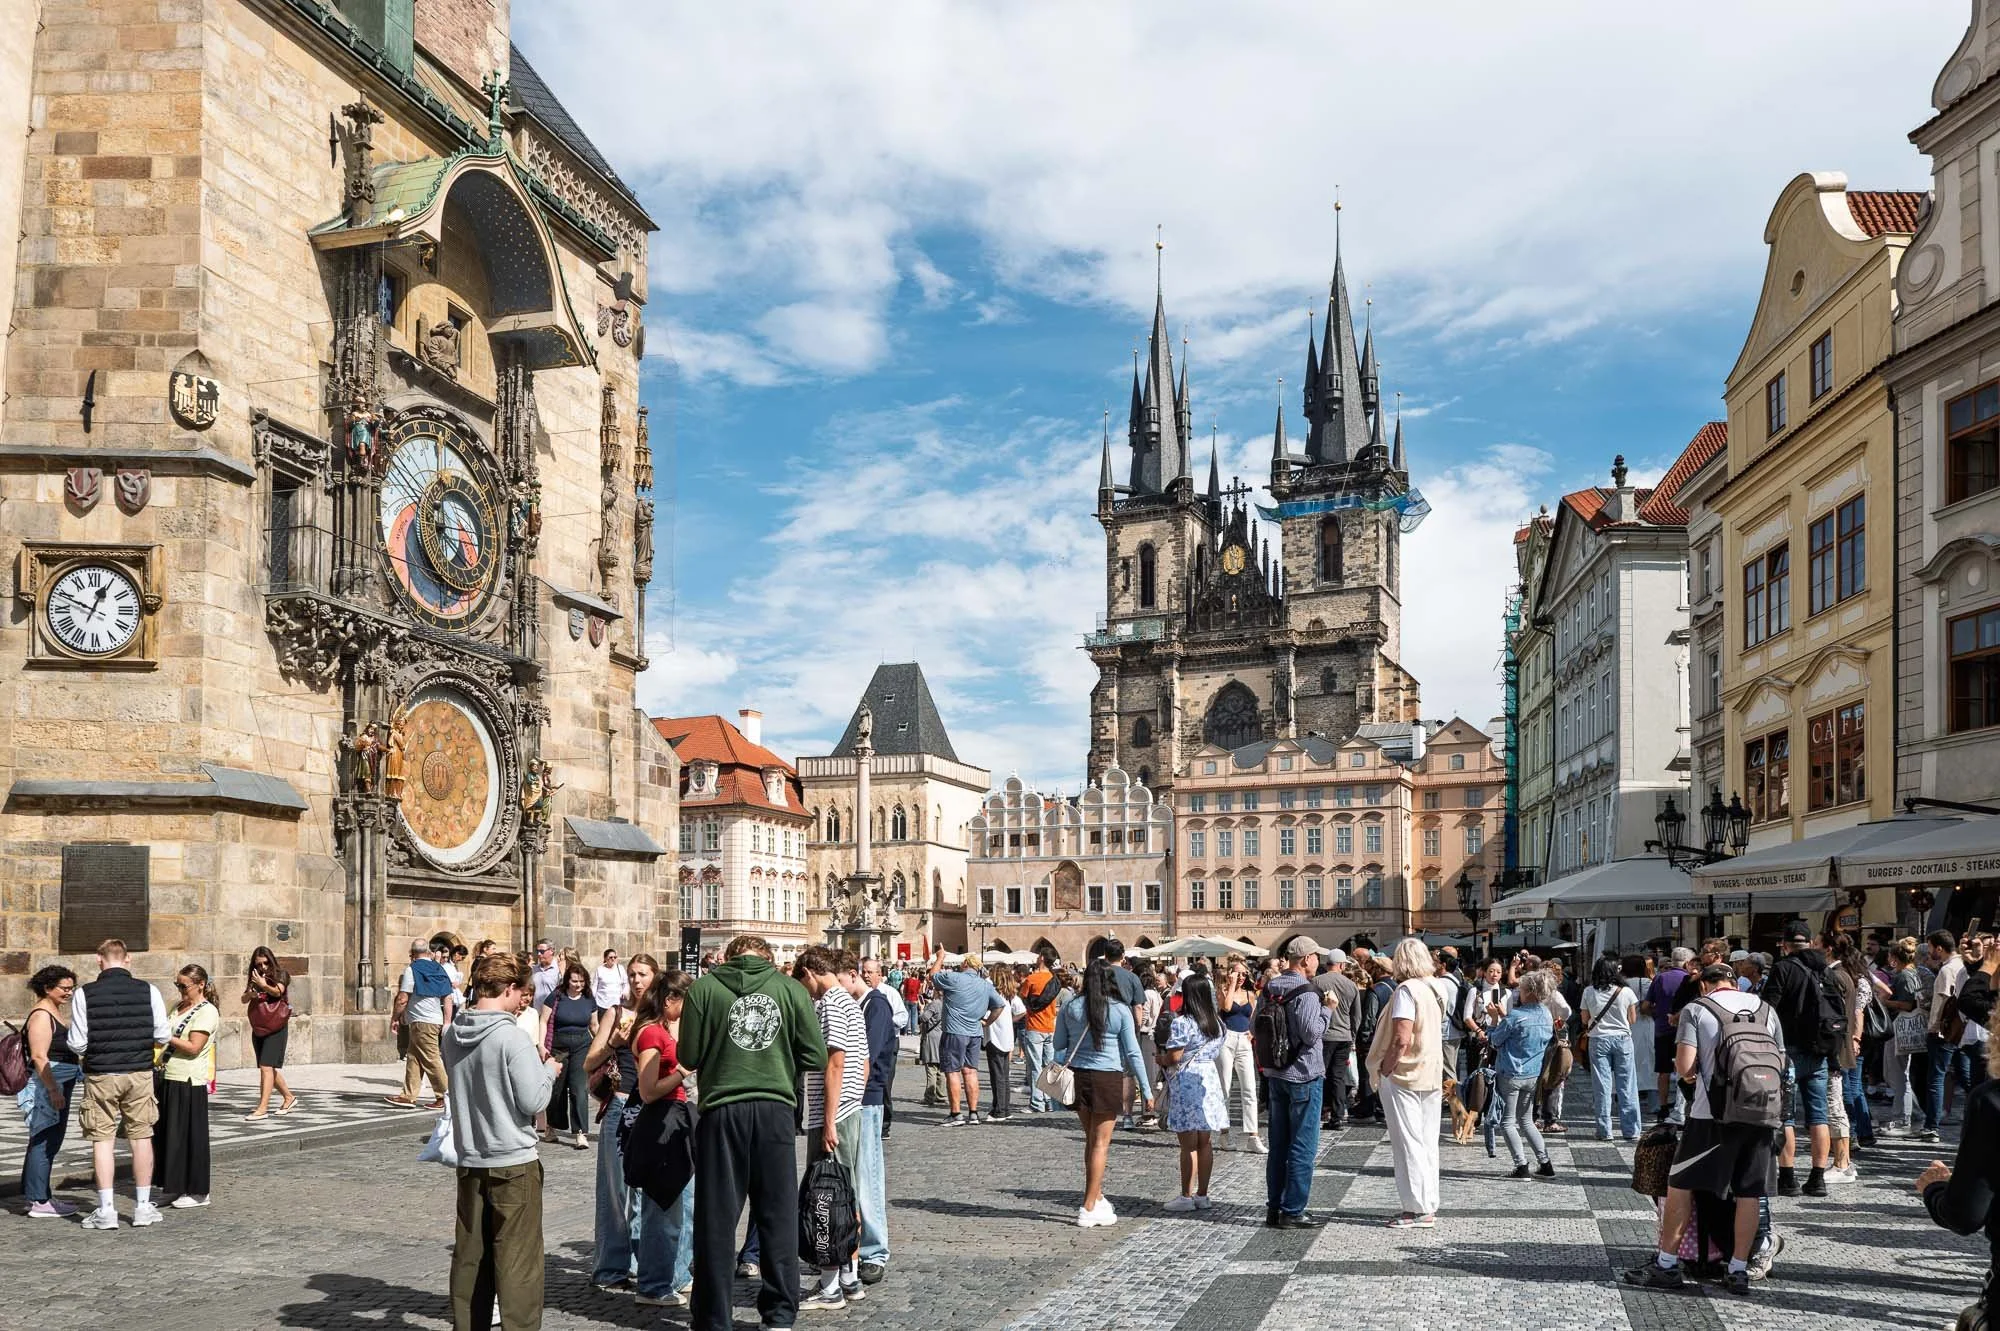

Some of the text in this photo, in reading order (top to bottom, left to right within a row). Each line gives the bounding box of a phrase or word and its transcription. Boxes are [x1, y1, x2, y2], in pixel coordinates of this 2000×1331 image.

[71, 576, 86, 592] XI
[87, 573, 101, 588] XII
[118, 606, 134, 616] III
[1866, 866, 1903, 878] BURGERS
[1910, 862, 1958, 875] COCKTAILS
[1966, 859, 2000, 872] STEAKS
[1712, 879, 1741, 889] BURGERS
[1745, 875, 1778, 887] COCKTAILS
[1783, 873, 1807, 884] STEAKS
[1225, 910, 1350, 920] DALI MUCHA WARHOL
[1635, 903, 1670, 912] BURGERS
